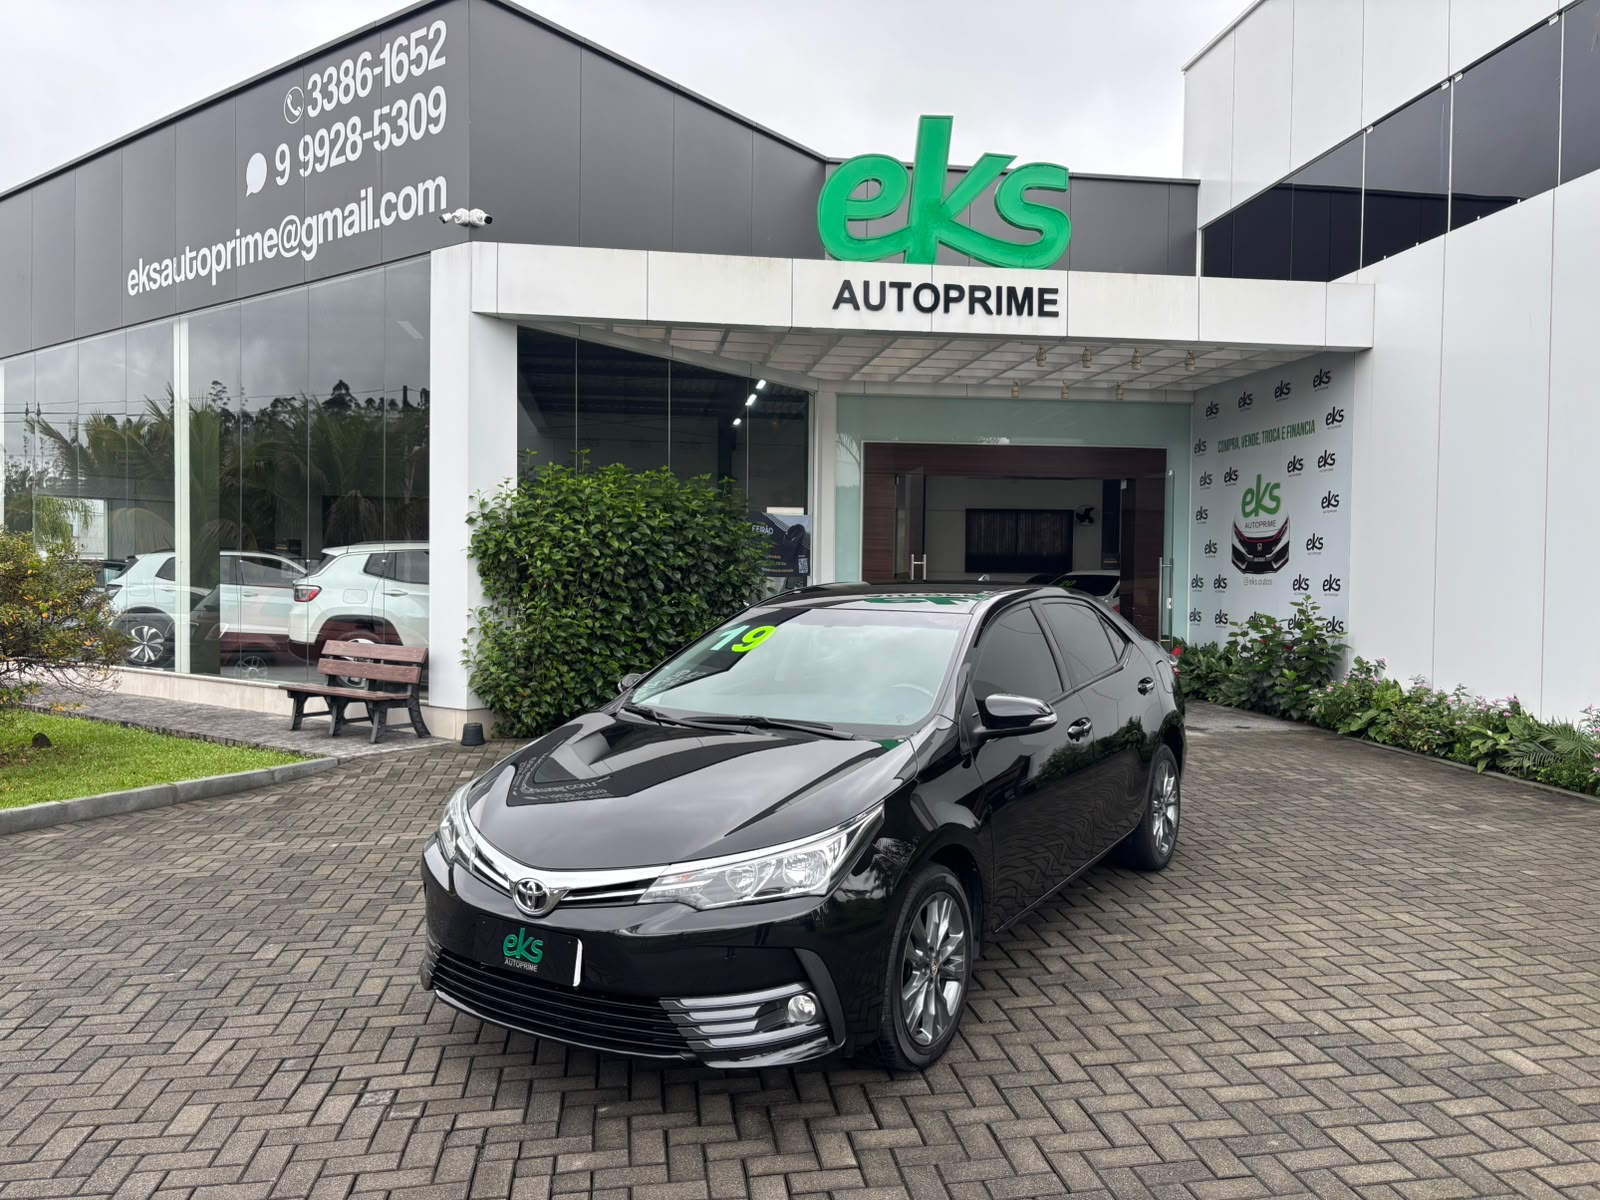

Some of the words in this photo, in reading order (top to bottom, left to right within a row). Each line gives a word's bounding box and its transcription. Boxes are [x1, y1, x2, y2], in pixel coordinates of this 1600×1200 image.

[307, 20, 447, 118] 3386-1652
[275, 143, 290, 186] 9
[299, 85, 446, 177] 9928-5309
[817, 115, 1072, 270] eks
[127, 175, 447, 296] eksautoprime@gmail.com
[832, 279, 1059, 317] AUTOPRIME
[1313, 368, 1331, 388] eks
[1274, 380, 1291, 399] eks
[1326, 406, 1344, 426] eks
[1262, 427, 1280, 443] TROCA
[1287, 419, 1316, 438] FINANCIA
[1287, 455, 1304, 473] eks
[1318, 450, 1336, 468] eks
[1241, 473, 1281, 518] eks
[1321, 490, 1339, 509] eks
[1245, 520, 1276, 529] AUTOPRIME
[1306, 533, 1324, 551] eks
[1293, 574, 1310, 591] eks
[1323, 574, 1341, 592] eks
[709, 625, 777, 652] 19
[503, 928, 543, 963] eks
[504, 957, 538, 972] AUTOPRIME
